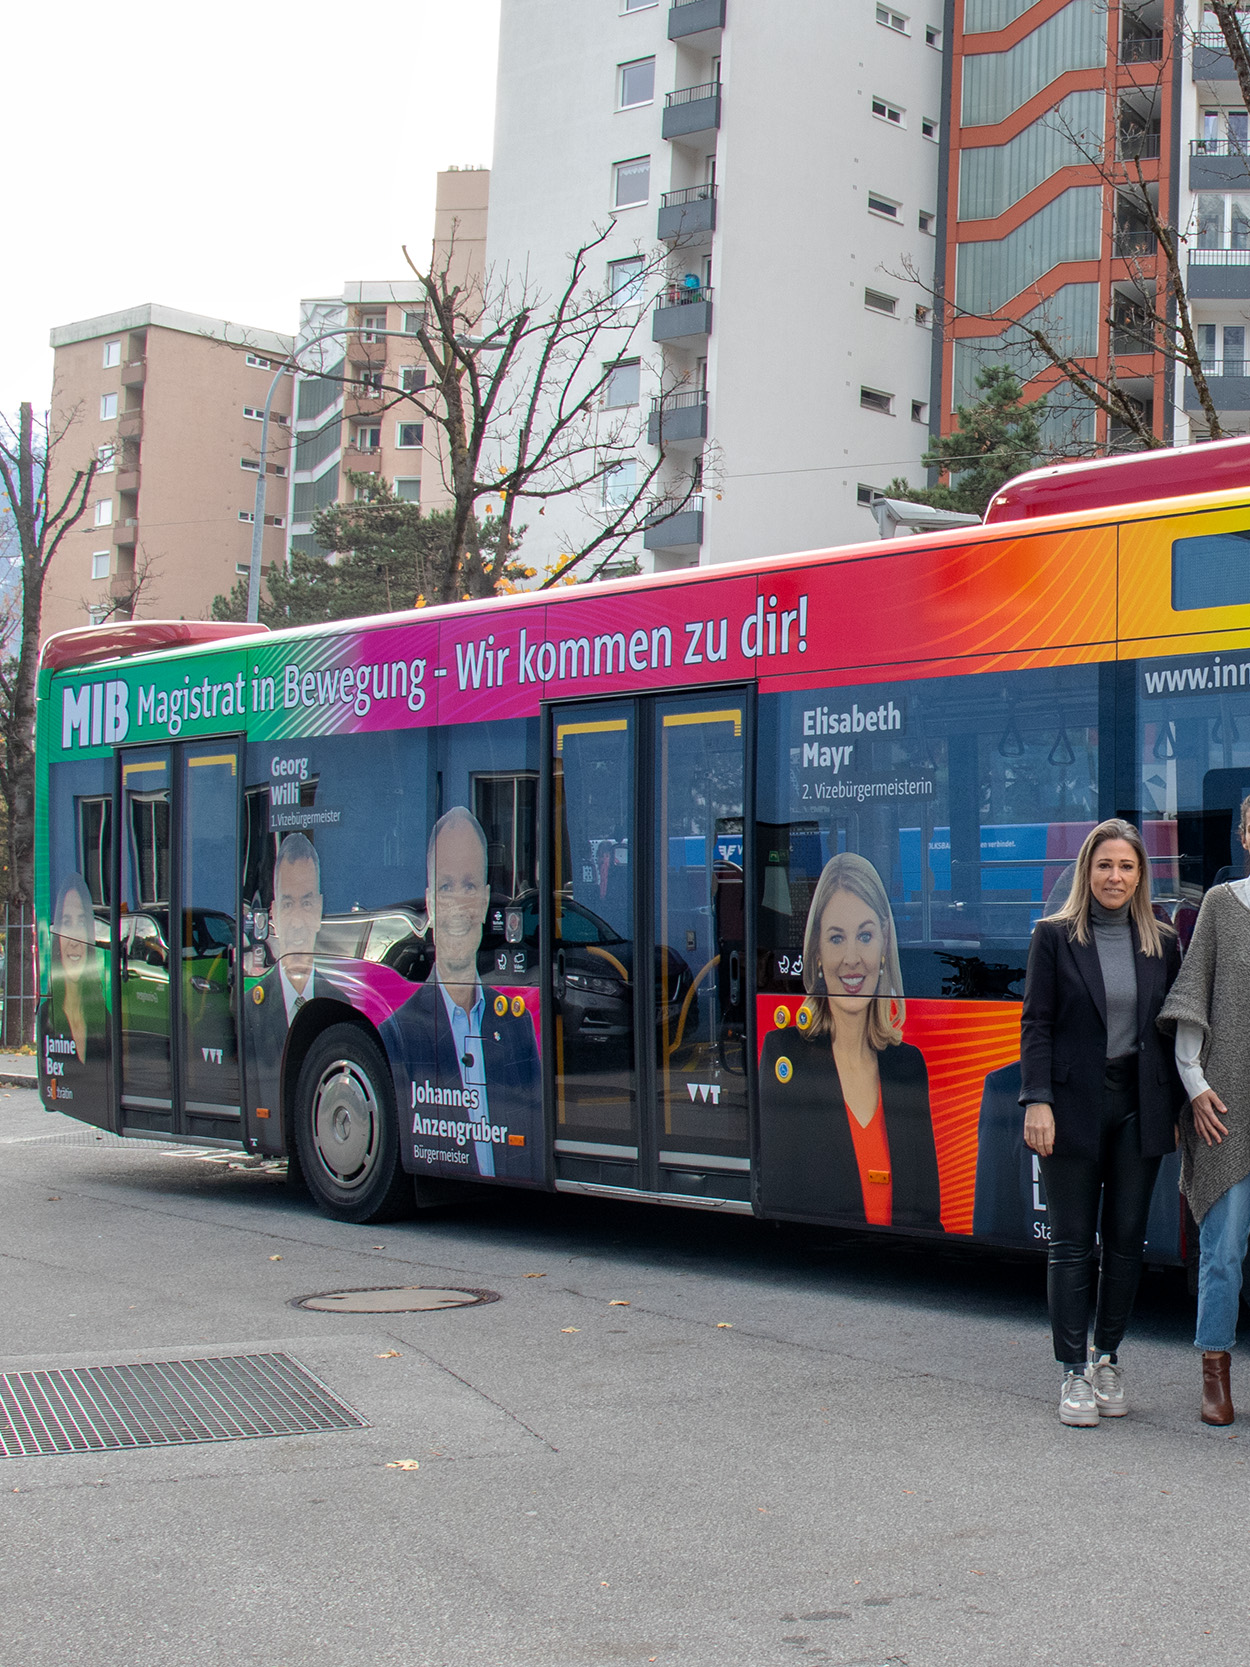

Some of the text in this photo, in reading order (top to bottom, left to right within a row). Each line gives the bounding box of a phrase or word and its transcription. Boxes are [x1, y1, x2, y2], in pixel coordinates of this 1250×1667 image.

[137, 593, 808, 736] Magistrat in Bewegung - Wir kommen zu dir!
[62, 679, 131, 749] MIB
[803, 701, 901, 736] Elisabeth
[271, 756, 309, 780] Georg
[803, 742, 853, 774] Mayr
[271, 781, 300, 806] Willi
[802, 776, 933, 802] 2. Vizebürgermeisterin
[45, 1034, 77, 1057] Janine
[46, 1058, 64, 1077] Bex
[411, 1080, 479, 1109] Johannes
[686, 1083, 721, 1105] VVT
[412, 1112, 508, 1147] Anzengruber
[413, 1144, 470, 1165] Bürgermeister
